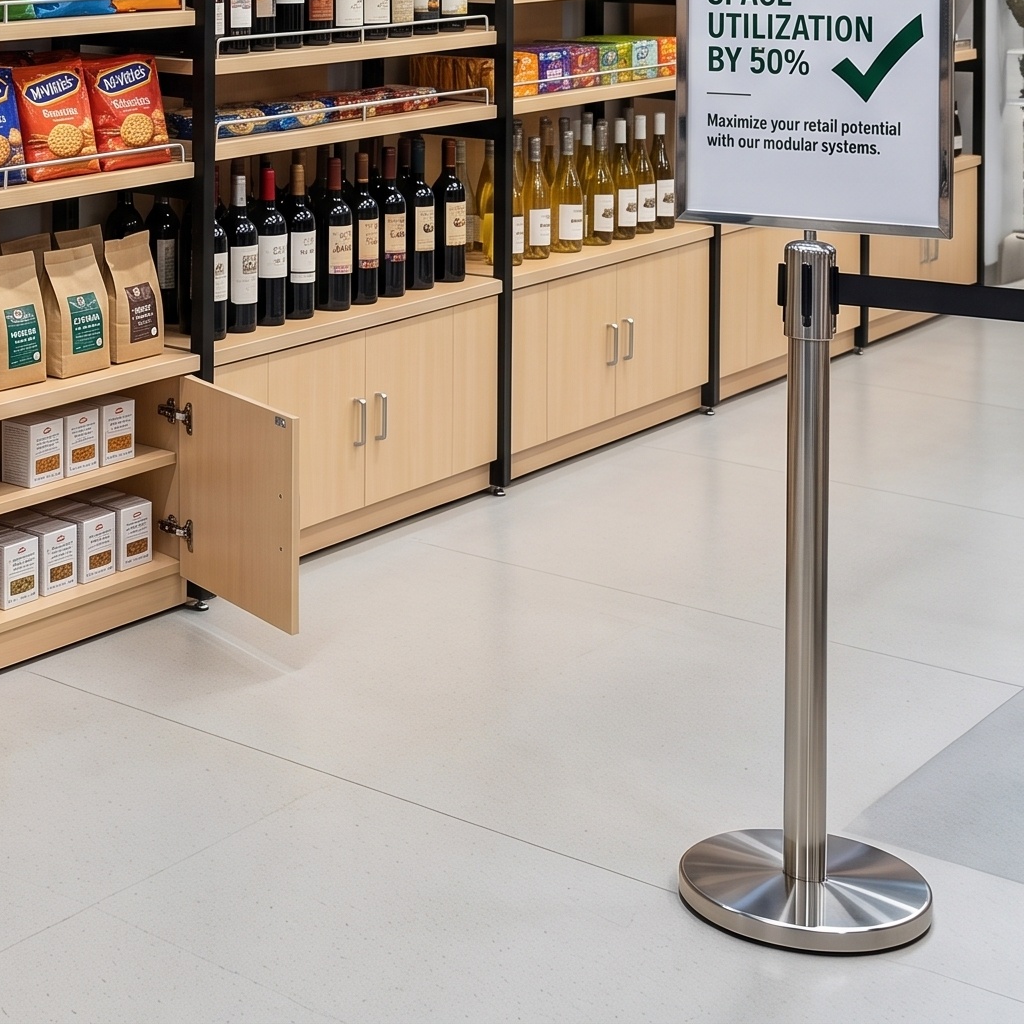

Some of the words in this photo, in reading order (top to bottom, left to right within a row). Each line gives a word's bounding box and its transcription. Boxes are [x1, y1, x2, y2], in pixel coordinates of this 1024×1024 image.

[708, 12, 873, 43] UTILIZATION
[708, 46, 742, 72] BY
[750, 47, 810, 75] 50%
[707, 113, 767, 130] Maximize
[771, 118, 800, 133] your
[804, 119, 838, 133] retail
[841, 121, 901, 136] potential
[707, 133, 734, 147] with
[738, 137, 760, 148] our
[763, 137, 818, 151] modular
[821, 140, 881, 156] systems.
